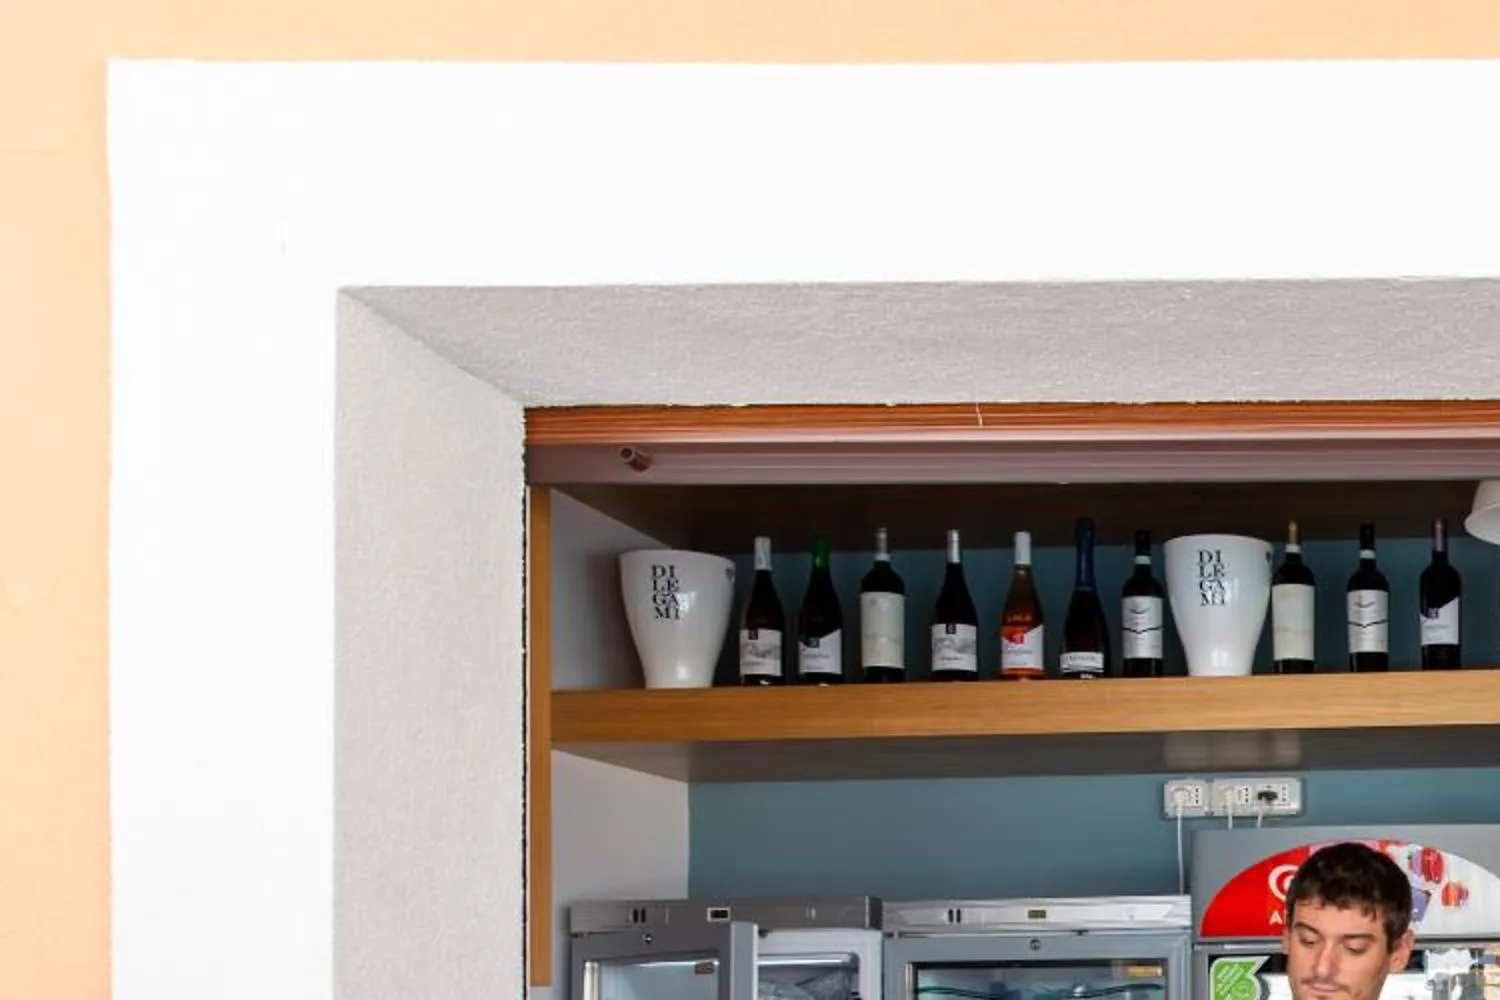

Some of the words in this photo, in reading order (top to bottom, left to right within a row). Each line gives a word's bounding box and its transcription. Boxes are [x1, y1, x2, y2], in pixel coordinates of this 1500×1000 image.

[1198, 549, 1222, 563] DI
[651, 564, 675, 579] DI
[1199, 563, 1226, 578] LE
[652, 579, 680, 592] LE
[652, 591, 680, 606] GA
